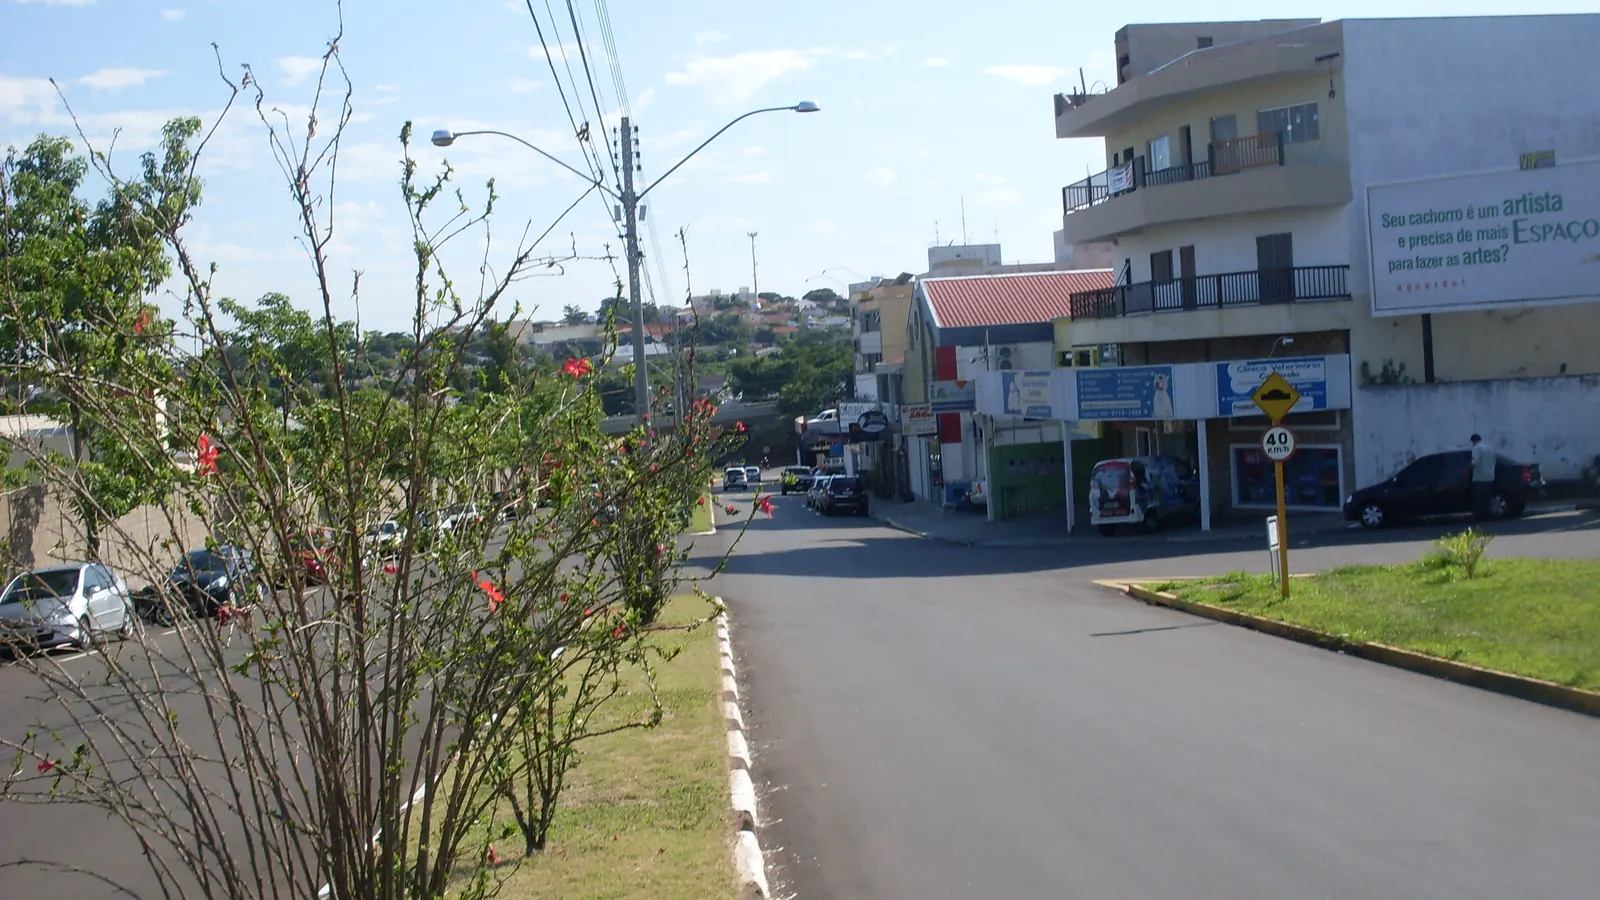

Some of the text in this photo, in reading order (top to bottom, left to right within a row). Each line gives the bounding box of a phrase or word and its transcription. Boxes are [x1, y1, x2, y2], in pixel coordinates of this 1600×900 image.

[1382, 192, 1564, 229] Seu cachorro é um artista
[1398, 237, 1405, 249] e
[1409, 230, 1453, 251] precisa
[1457, 227, 1473, 244] de
[1477, 225, 1509, 242] mais
[1388, 244, 1510, 274] para fazer as artes?
[1266, 432, 1288, 446] 40
